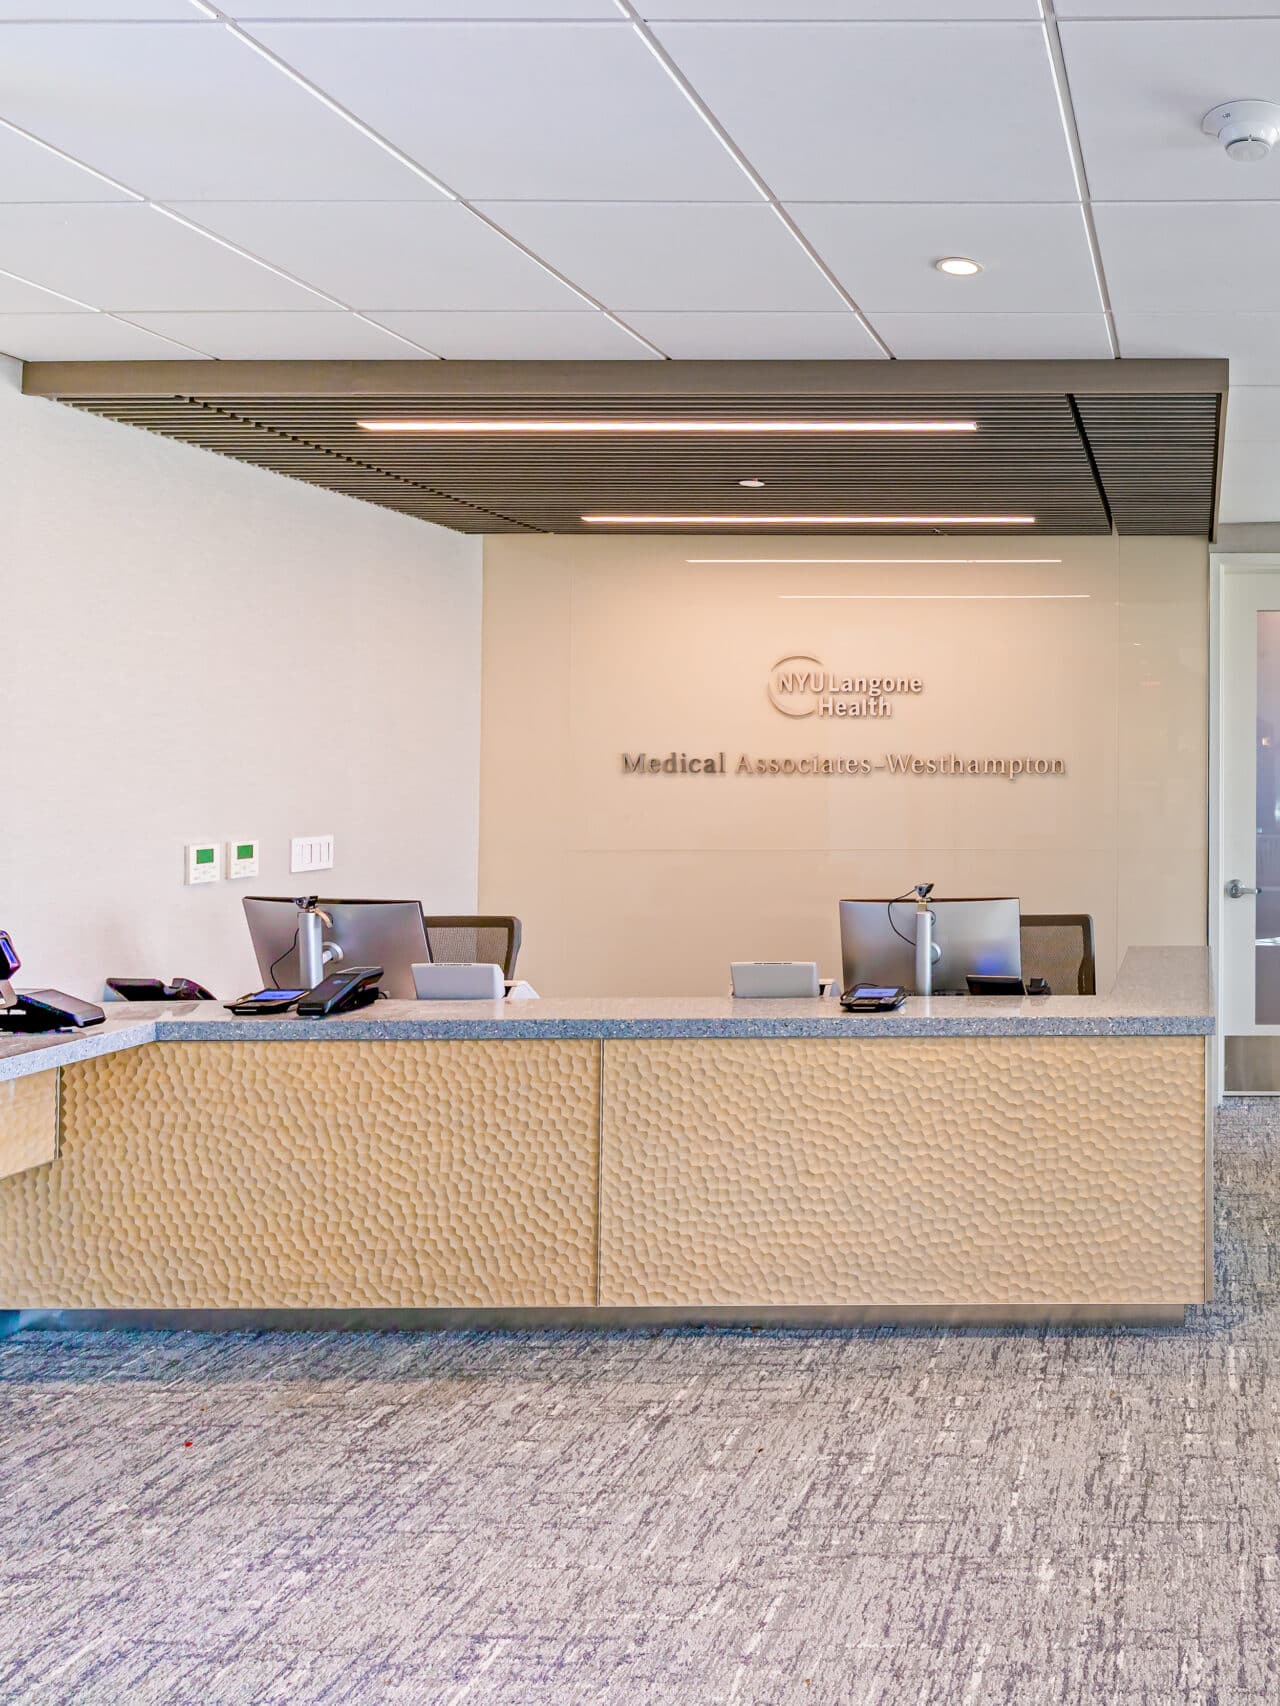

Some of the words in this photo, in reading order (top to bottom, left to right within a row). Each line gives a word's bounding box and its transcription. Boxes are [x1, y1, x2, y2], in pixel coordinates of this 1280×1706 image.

[779, 672, 824, 692] NYU
[828, 672, 922, 697] Langone
[818, 697, 892, 717] Health
[621, 752, 726, 774] Medical
